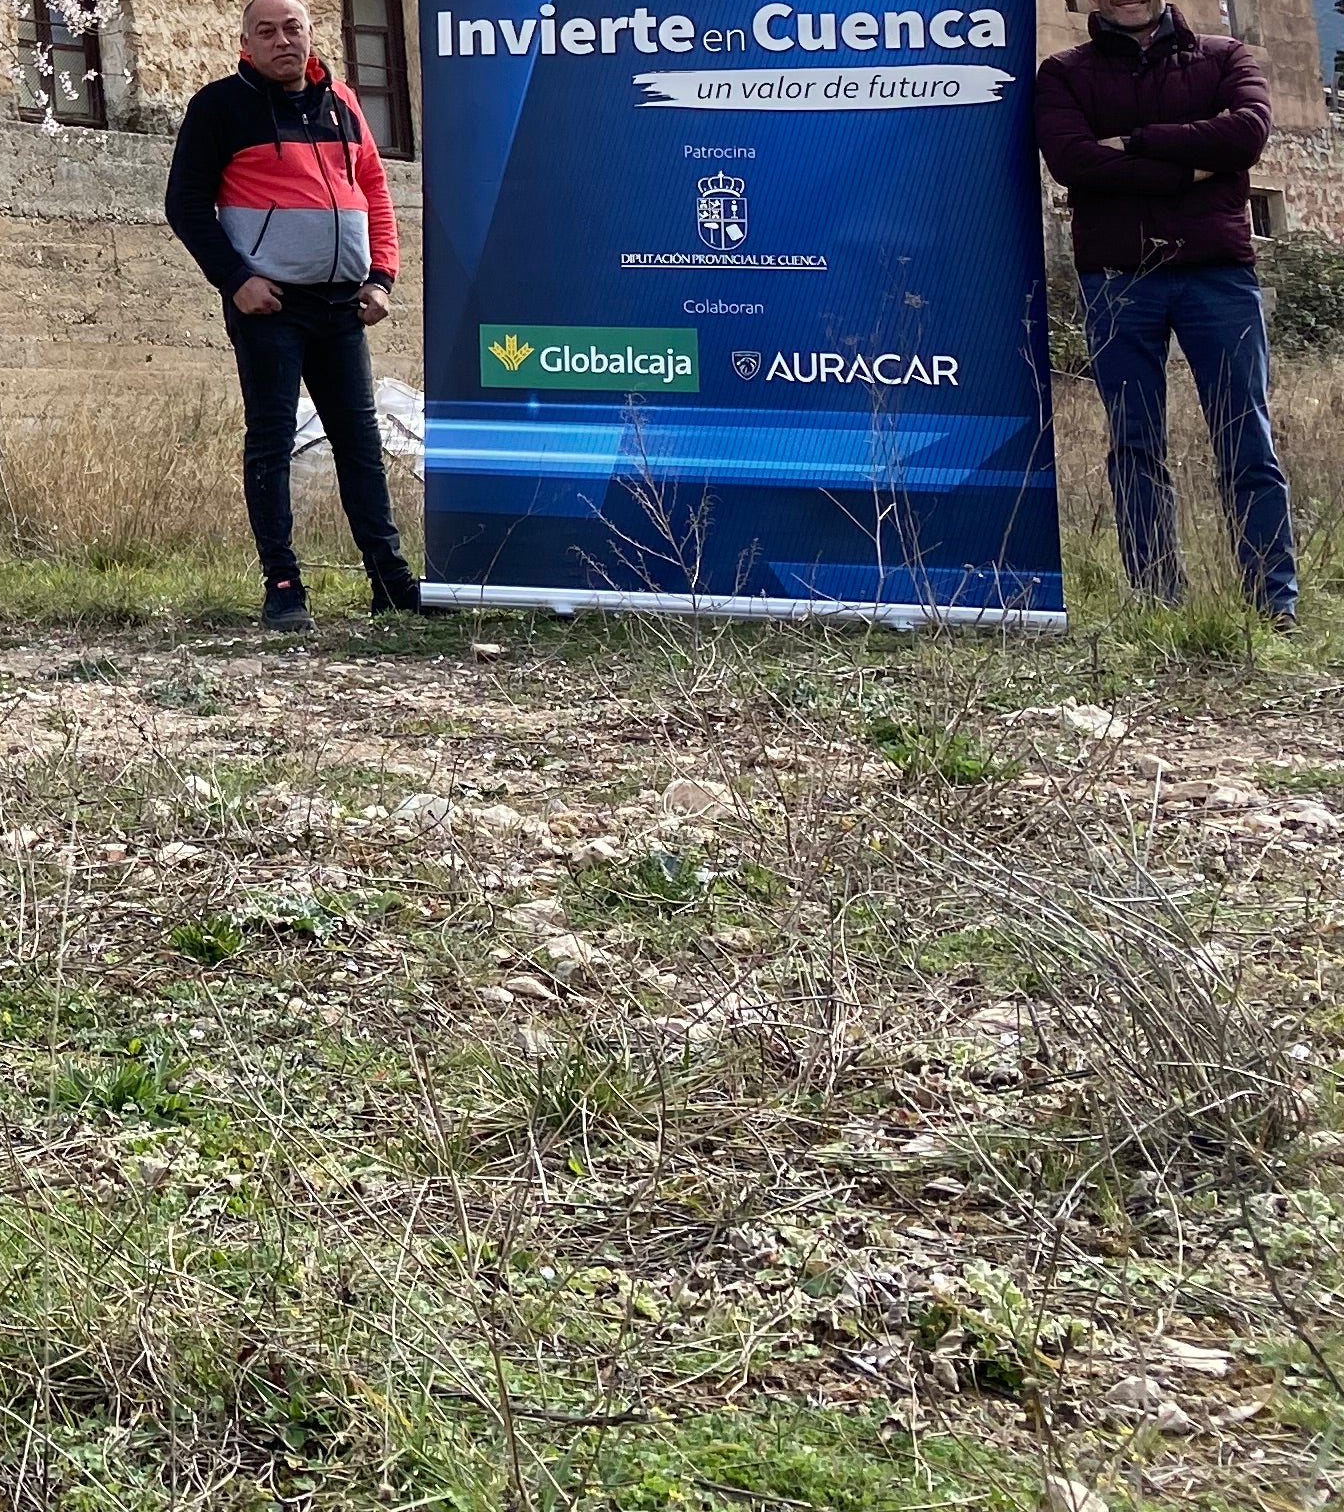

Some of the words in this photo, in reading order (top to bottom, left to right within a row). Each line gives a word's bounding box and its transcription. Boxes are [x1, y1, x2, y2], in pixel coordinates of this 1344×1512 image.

[437, 4, 695, 57] Invierte
[703, 26, 746, 52] en
[752, 3, 1007, 52] Cuenca
[696, 82, 732, 100] un
[741, 76, 817, 99] valor
[822, 74, 861, 98] de
[867, 73, 961, 99] futuro
[683, 144, 757, 160] Patrocina
[621, 252, 691, 264] DIPUTACIÓN
[692, 254, 759, 265] PROVINCIAL
[761, 255, 777, 265] DE
[777, 256, 827, 266] CUENCA
[683, 299, 765, 315] Colaboran
[540, 345, 693, 383] Globalcaja
[765, 351, 960, 386] AURACAR
